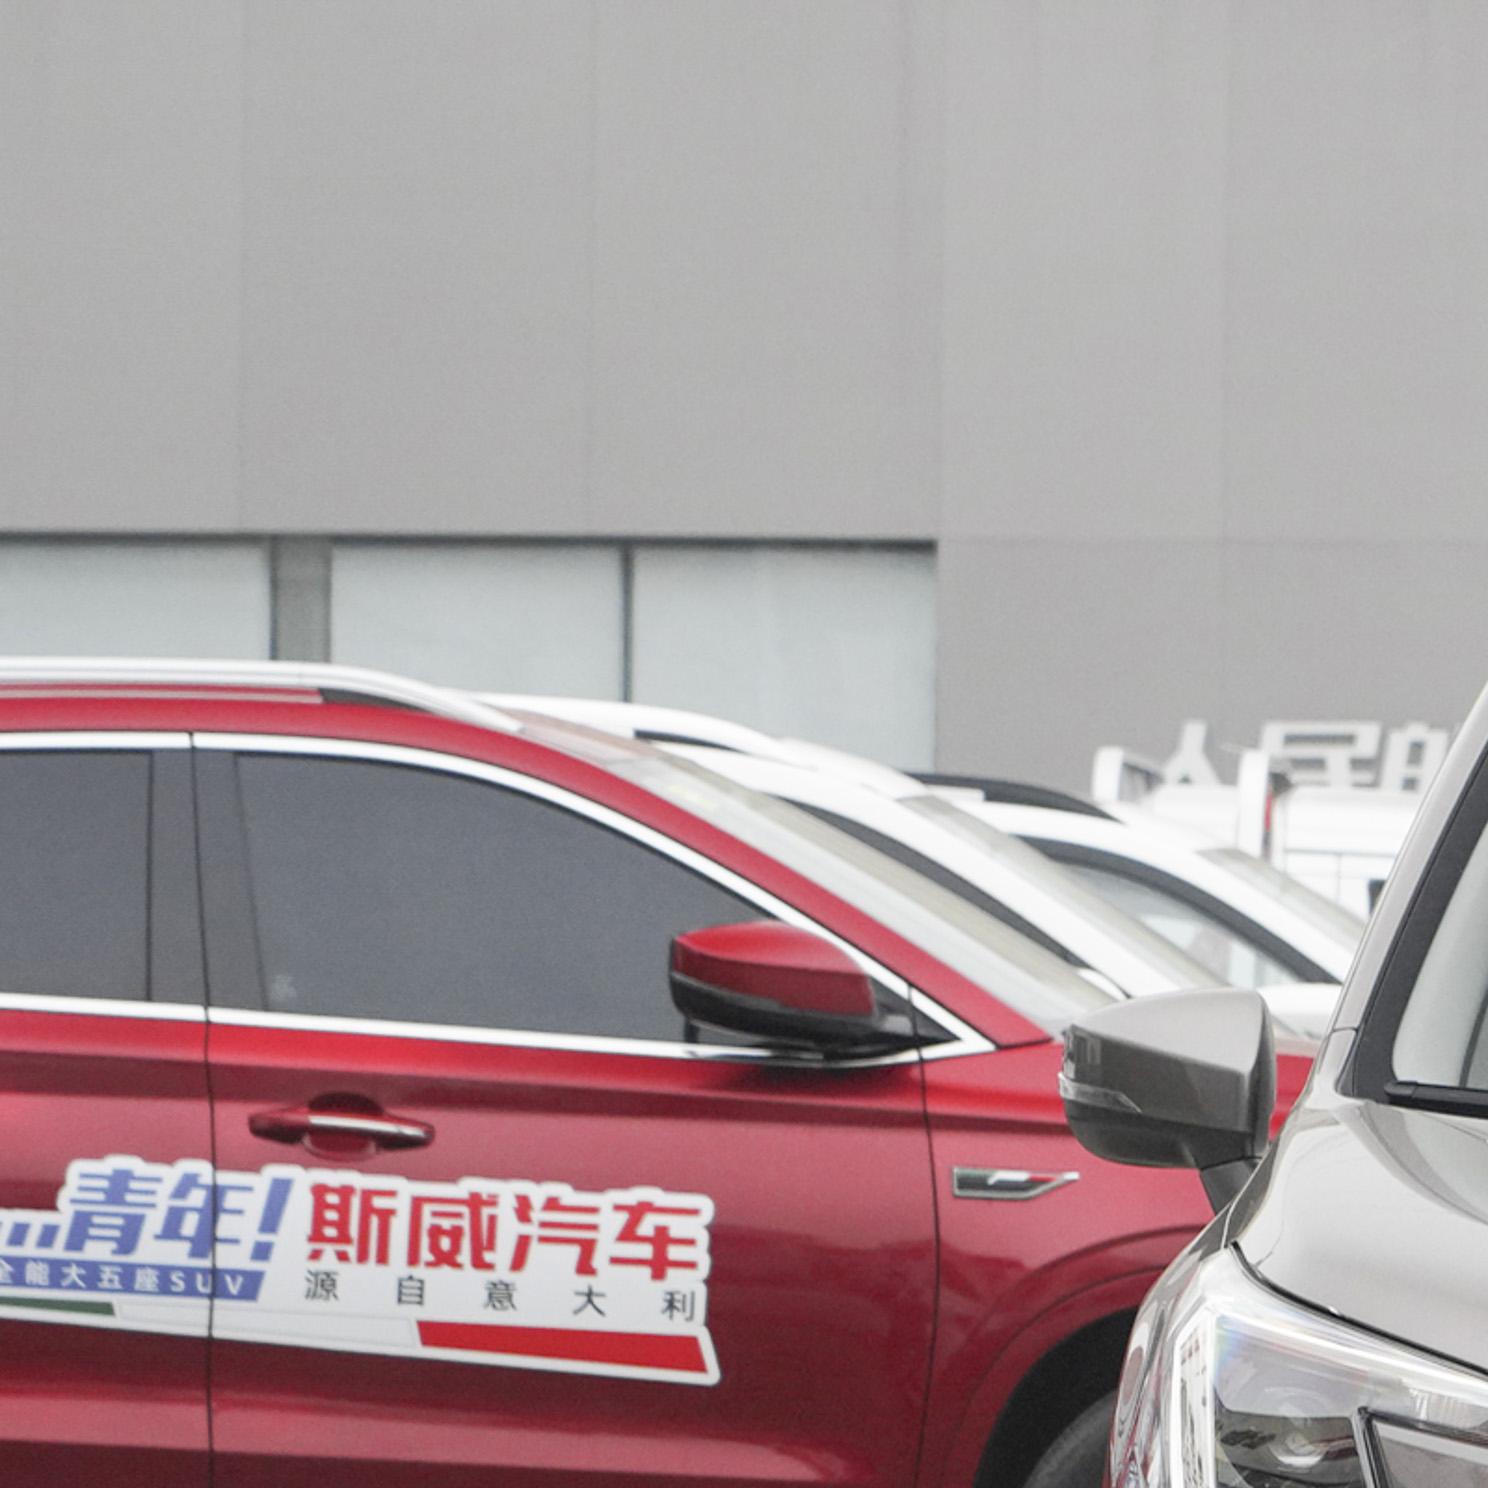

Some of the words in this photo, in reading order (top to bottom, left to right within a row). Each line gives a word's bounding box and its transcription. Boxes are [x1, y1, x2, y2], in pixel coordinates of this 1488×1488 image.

[307, 1183, 701, 1282] 斯威汽车
[304, 1269, 697, 1322] 源自意大利
